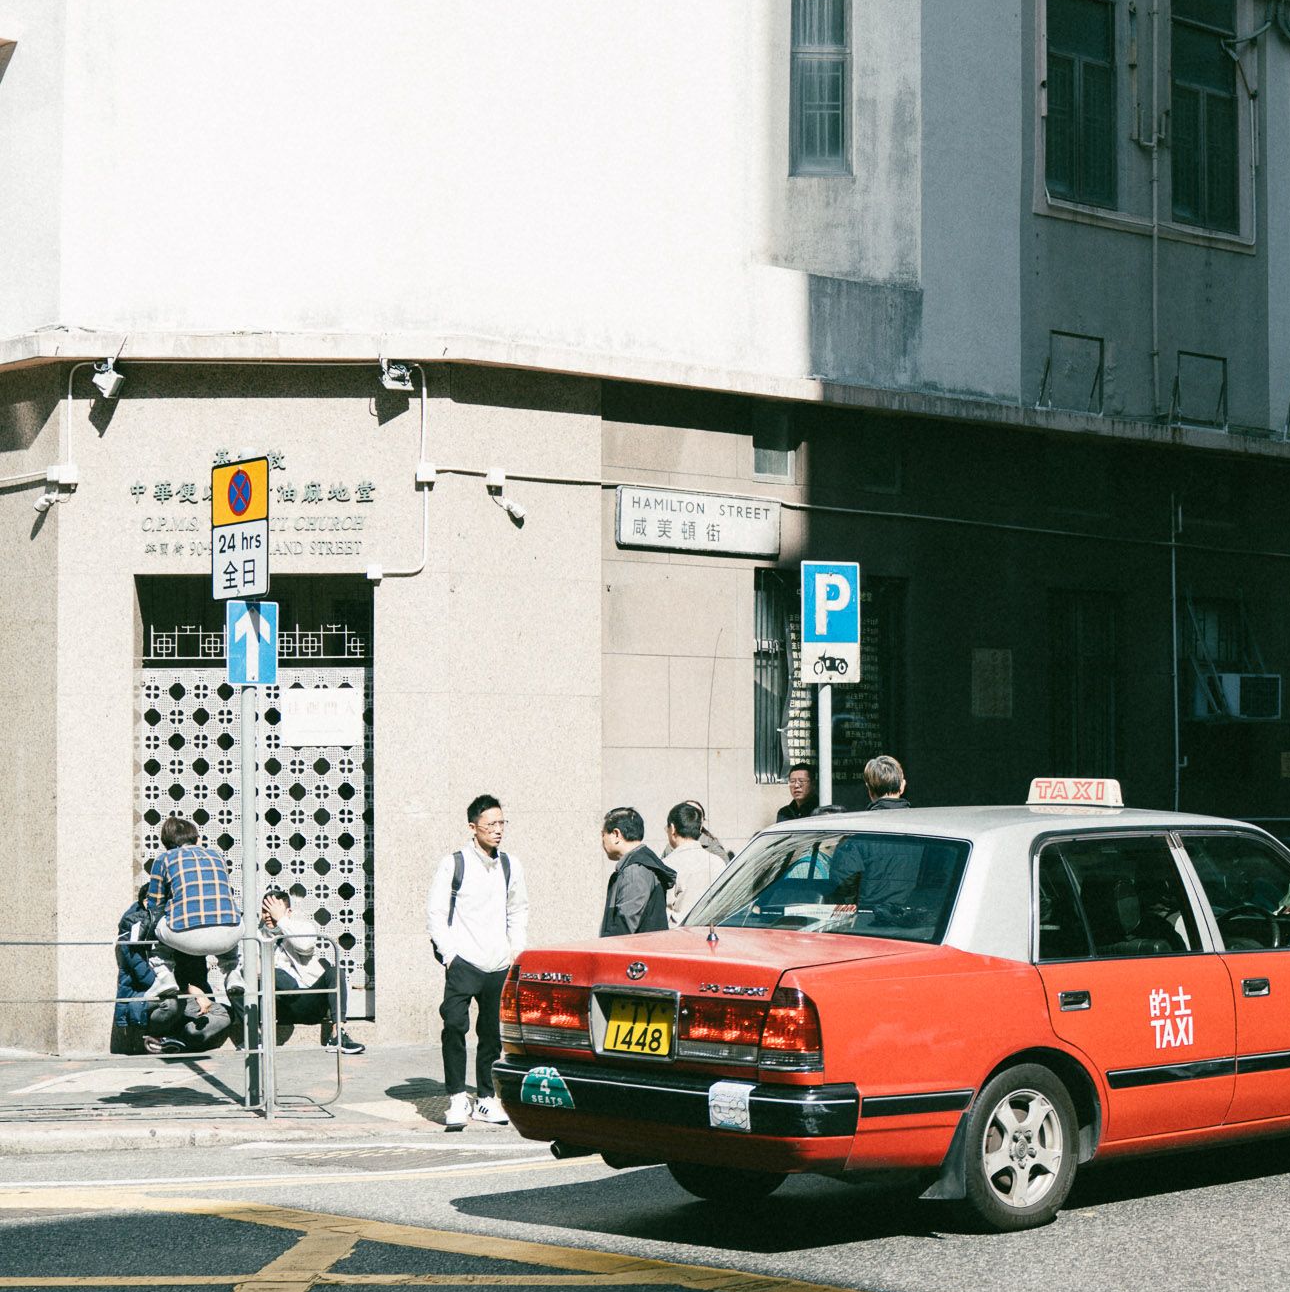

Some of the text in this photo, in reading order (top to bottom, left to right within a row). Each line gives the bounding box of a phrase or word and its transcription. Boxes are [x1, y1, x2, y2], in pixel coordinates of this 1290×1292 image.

[631, 495, 771, 520] HAMILTON STREET
[294, 516, 367, 532] CHURCH
[632, 518, 721, 543] 咸美頓街
[218, 533, 236, 554] 24
[241, 531, 262, 551] hrs
[309, 540, 362, 556] STREET
[222, 559, 256, 589] 全日
[815, 573, 851, 636] P
[1034, 780, 1106, 801] TAXI
[630, 1001, 657, 1026] TY
[1149, 986, 1192, 1017] 的士
[613, 1024, 662, 1052] 1448
[1150, 1017, 1194, 1050] TAXI
[540, 1079, 551, 1095] 4
[531, 1094, 563, 1106] SEATS
